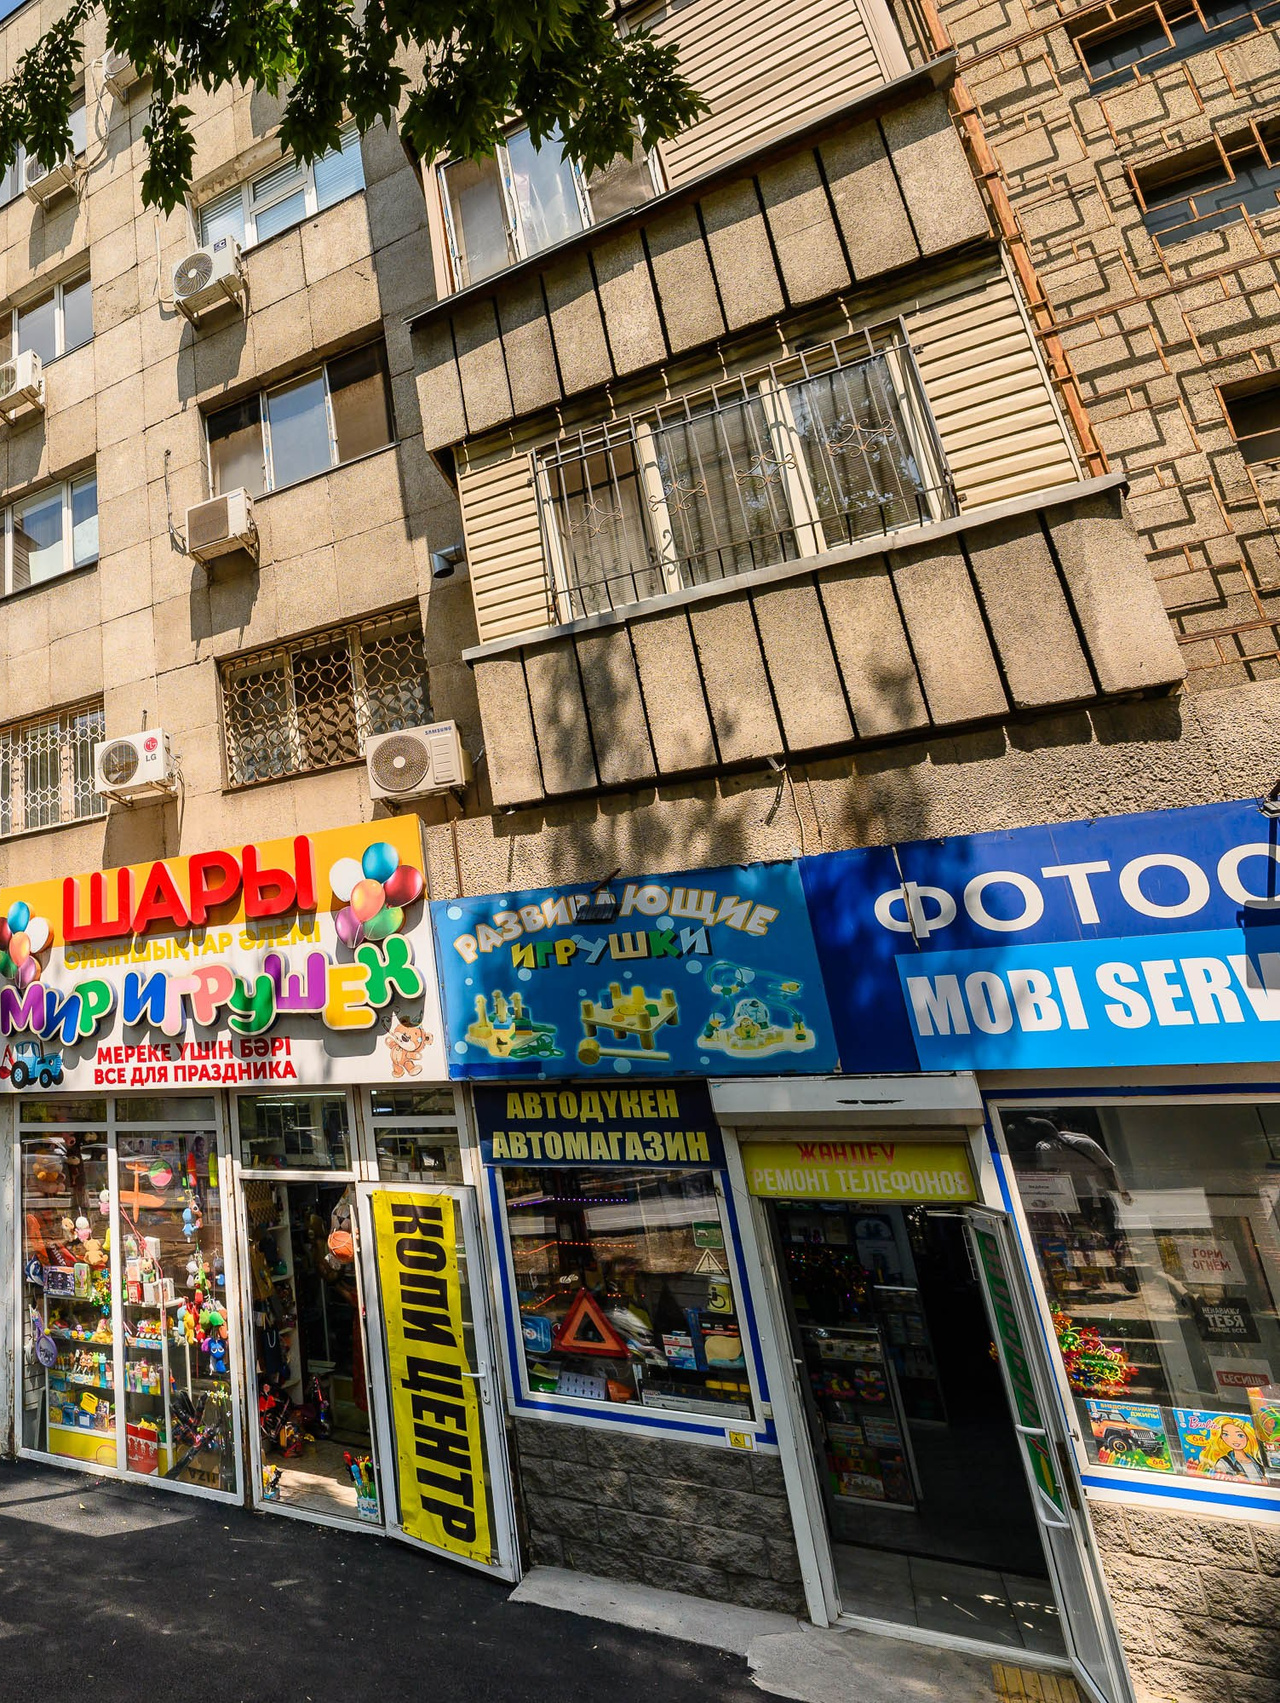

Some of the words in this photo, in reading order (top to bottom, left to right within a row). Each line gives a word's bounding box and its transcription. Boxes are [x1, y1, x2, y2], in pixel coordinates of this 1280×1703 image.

[424, 726, 451, 735] SAMSUNG
[145, 753, 157, 762] LG
[62, 835, 318, 944] ШАРЫ
[874, 842, 1280, 938] ФОТОС
[241, 922, 321, 951] ӘЛЕМІ
[511, 926, 713, 968] ИГРУШКИ
[0, 978, 116, 1046] МИР
[122, 934, 424, 1037] ИГРУШЕК
[906, 966, 1089, 1036] MOBI
[1095, 952, 1280, 1029] SERV
[97, 1042, 173, 1065] МЕРЕКЕ
[177, 1038, 234, 1060] ҮШІН
[240, 1036, 292, 1057] БӘРІ
[94, 1066, 127, 1085] ВСЕ
[131, 1063, 169, 1086] ДЛЯ
[174, 1060, 297, 1083] ПРАЗДНИКА
[506, 1089, 680, 1124] АВТОДҮКЕН
[493, 1131, 711, 1163] АВТОМАГАЗИН
[797, 1142, 895, 1167] ЖӨНДЕУ
[753, 1169, 835, 1194] РЕМОНТ
[839, 1170, 972, 1197] ТЕЛЕФОНОВ
[1192, 1248, 1223, 1259] ГОРИ
[1192, 1258, 1231, 1271] ОГНЁМ
[391, 1203, 459, 1348] КОПИ
[1204, 1314, 1245, 1328] ТЕБЯ
[1221, 1373, 1265, 1386] БЕСИШЬ
[1100, 1403, 1158, 1412] ВНЕДОРОЖНИКИ
[1130, 1411, 1160, 1419] ДЖИПЫ
[1188, 1415, 1221, 1430] Barbie
[401, 1356, 477, 1544] ЦЕНТР
